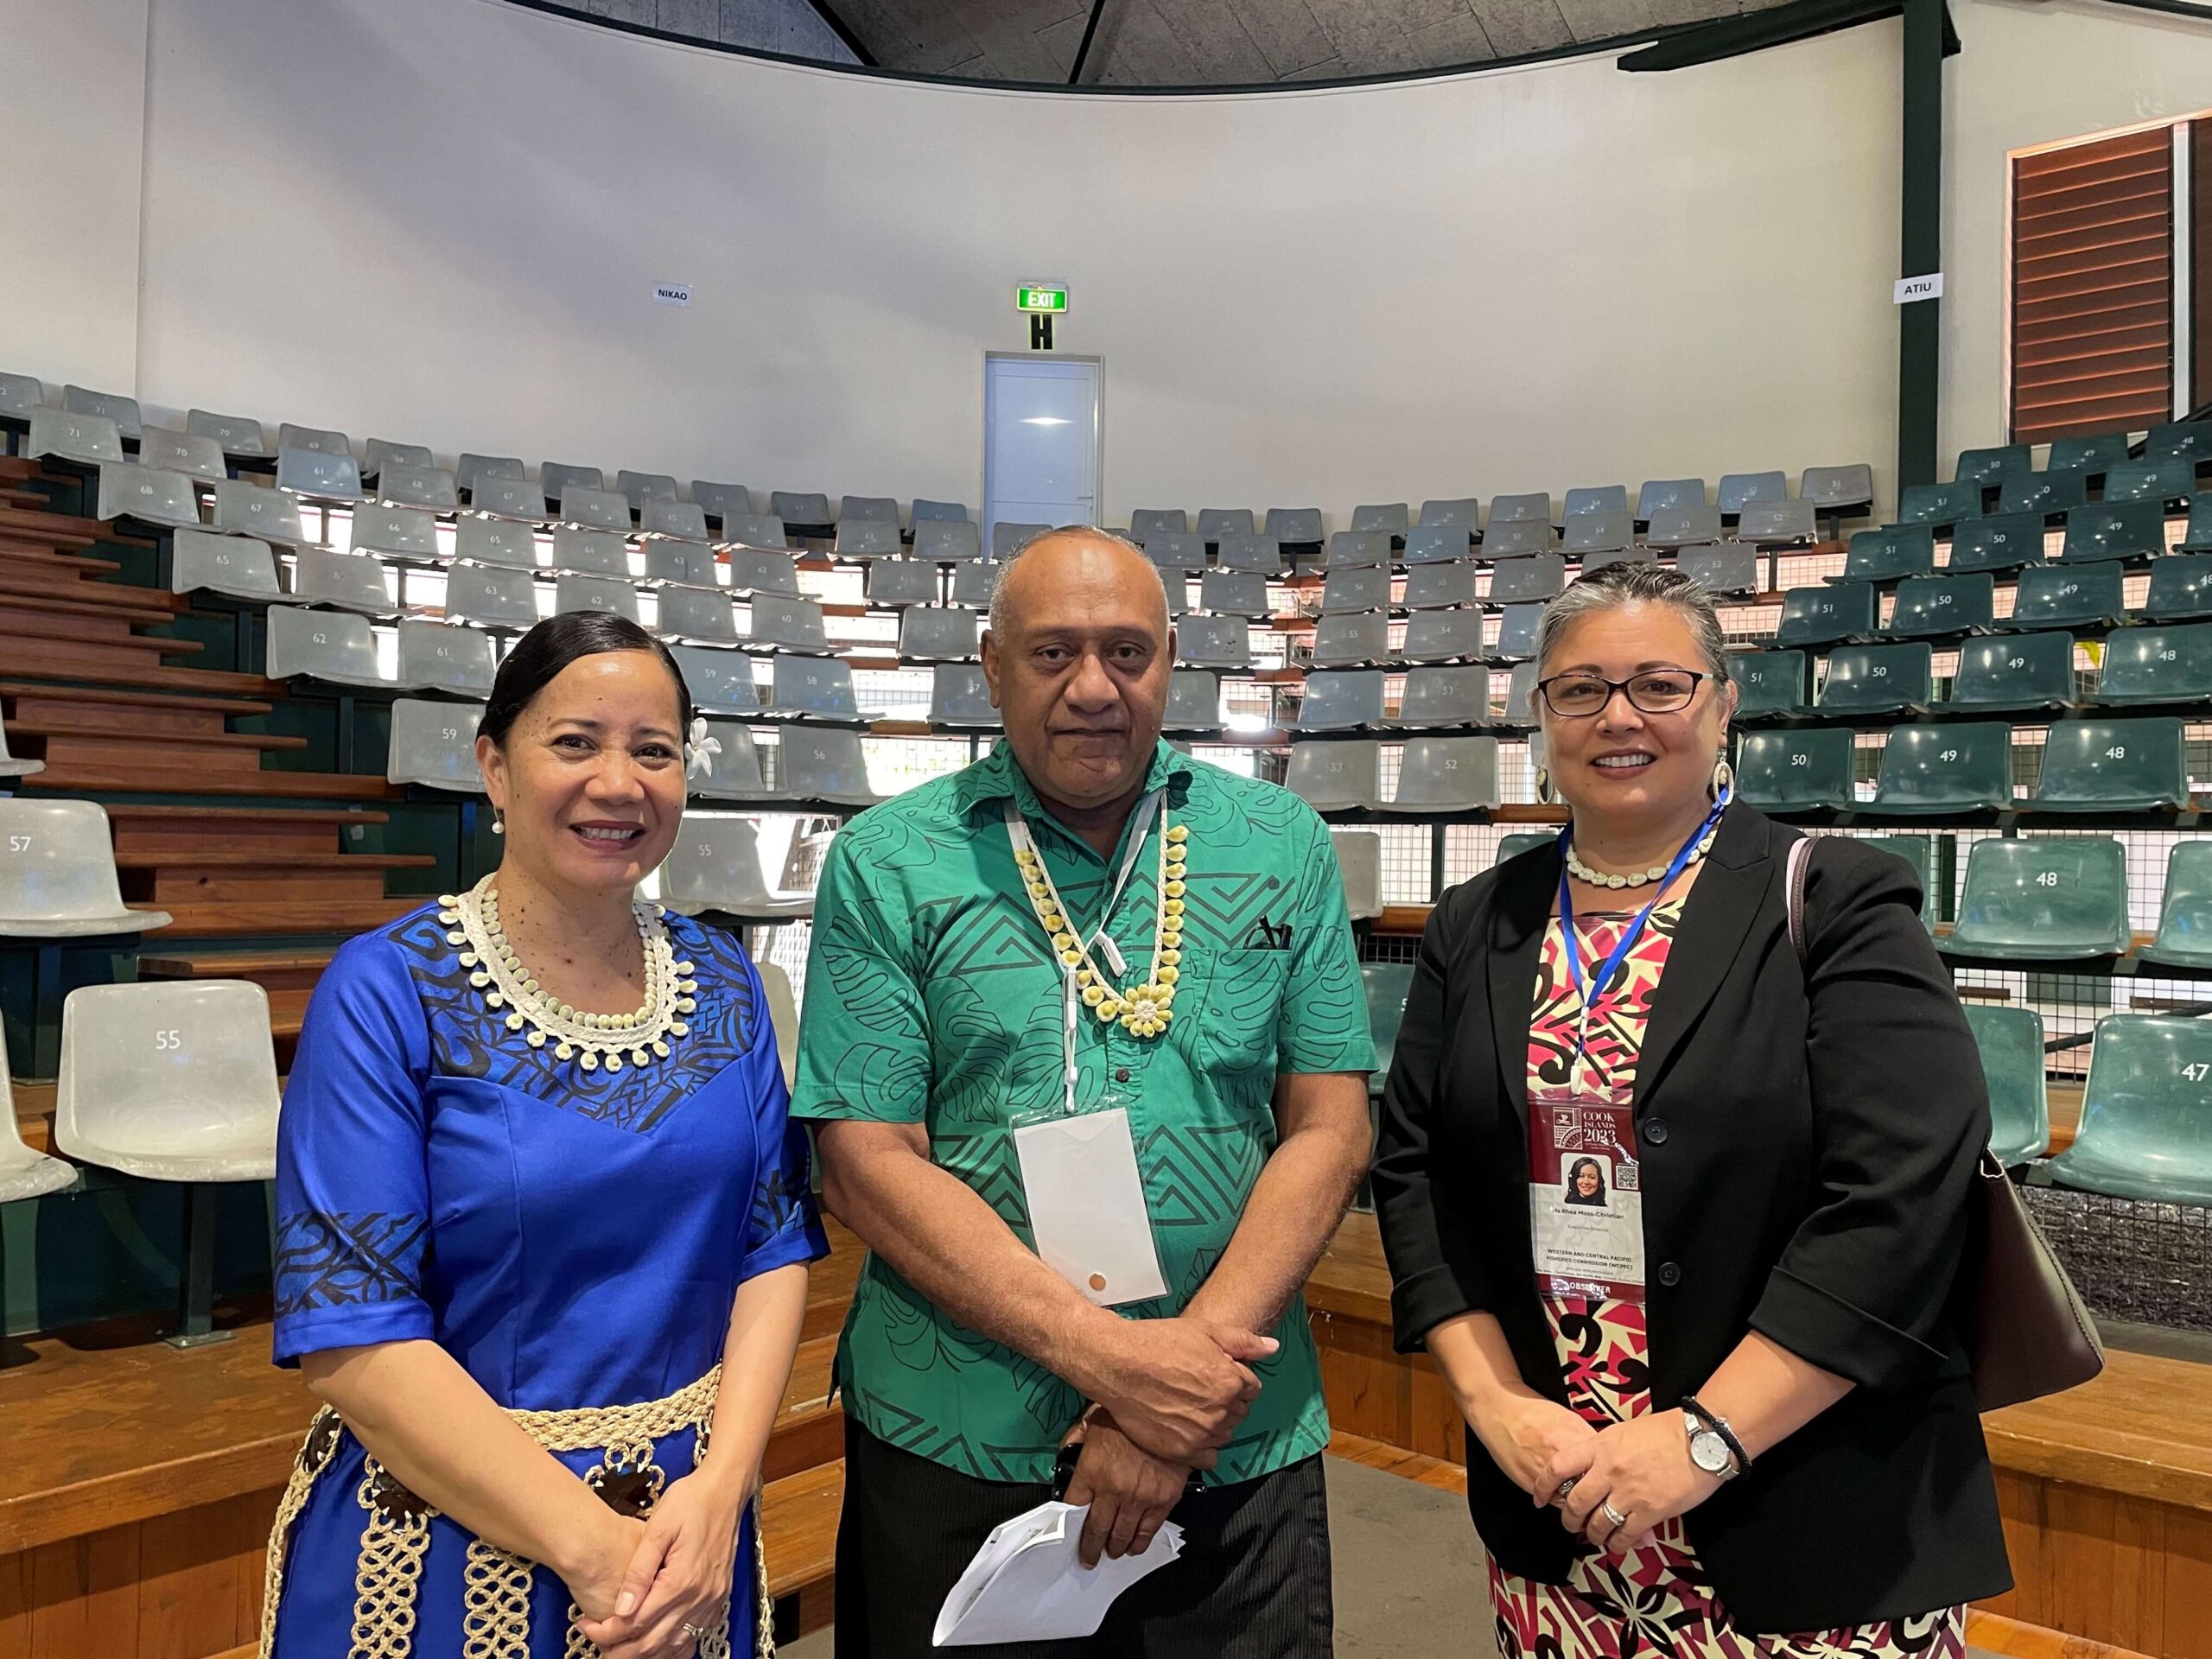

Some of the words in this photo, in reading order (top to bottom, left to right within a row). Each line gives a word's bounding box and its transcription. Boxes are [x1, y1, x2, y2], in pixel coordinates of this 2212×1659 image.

[1904, 282, 1932, 295] ATIU
[658, 289, 688, 301] NIKAO
[1028, 291, 1056, 308] EXIT
[69, 429, 80, 437] 71
[175, 448, 188, 457] 70
[2084, 449, 2095, 458] 49
[1990, 461, 2000, 469] 50
[2145, 474, 2157, 483] 49
[140, 486, 153, 495] 68
[251, 504, 261, 512] 67
[389, 524, 399, 532] 66
[2110, 523, 2123, 531] 49
[490, 536, 500, 544] 65
[1993, 535, 2005, 543] 50
[1885, 545, 1897, 554] 51
[216, 556, 228, 565] 65
[486, 586, 497, 595] 63
[2063, 584, 2078, 594] 49
[591, 595, 602, 604] 62
[1938, 595, 1952, 605] 50
[1822, 604, 1834, 613] 51
[1440, 626, 1451, 634] 54
[313, 634, 327, 644] 62
[1208, 632, 1217, 640] 56
[437, 648, 448, 657] 61
[2159, 651, 2177, 661] 48
[2009, 658, 2024, 669] 49
[705, 670, 716, 678] 59
[1872, 666, 1886, 677] 50
[1751, 672, 1762, 683] 51
[1443, 686, 1453, 695] 53
[442, 728, 456, 740] 59
[814, 750, 825, 760] 56
[1941, 750, 1957, 762] 49
[2105, 747, 2124, 760] 48
[1445, 760, 1458, 769] 52
[1791, 754, 1807, 766] 50
[1330, 762, 1343, 772] 53
[10, 836, 31, 851] 57
[699, 845, 712, 855] 55
[2036, 873, 2057, 887] 48
[1401, 998, 1408, 1012] 5
[156, 1030, 181, 1049] 55
[2182, 1064, 2209, 1081] 47
[1583, 1111, 1615, 1122] COOK
[1583, 1128, 1616, 1144] 2023
[1578, 1210, 1624, 1219] Moss-Christian
